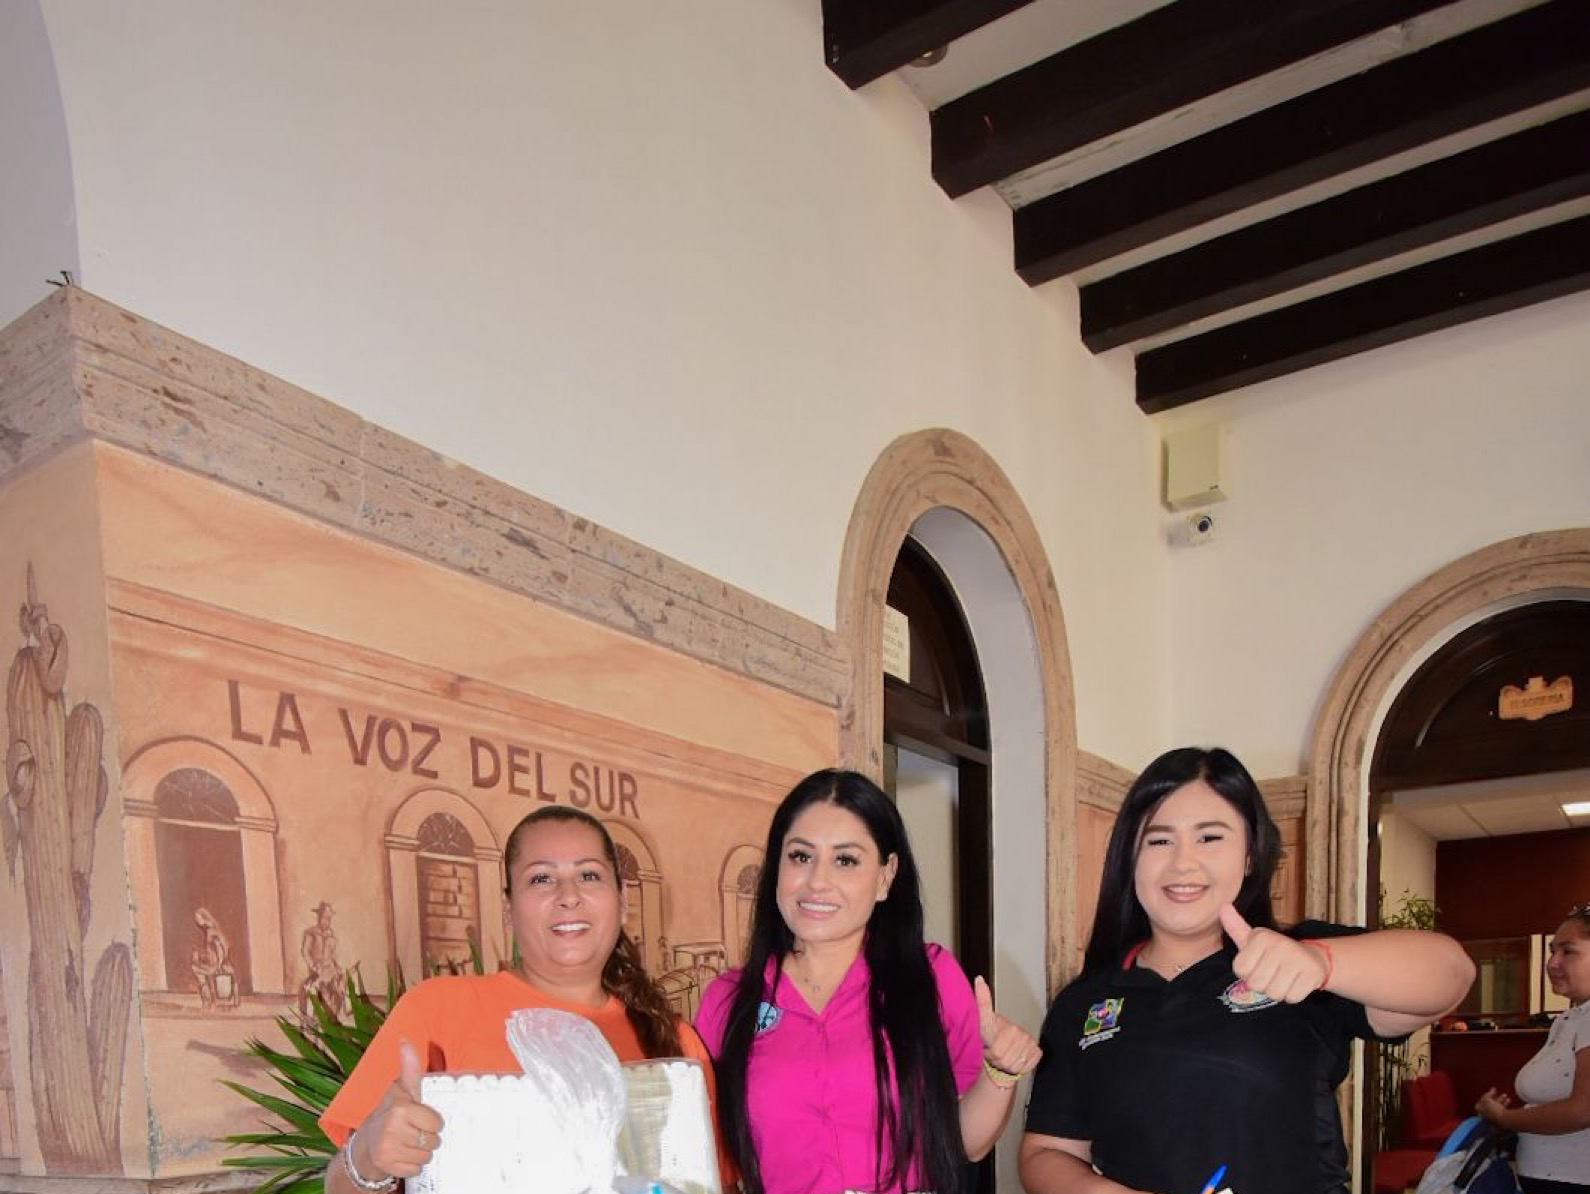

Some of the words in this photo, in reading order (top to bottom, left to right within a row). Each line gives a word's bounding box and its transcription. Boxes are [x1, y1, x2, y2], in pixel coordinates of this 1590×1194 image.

[227, 679, 312, 755] LA
[339, 707, 441, 779] VOZ
[469, 736, 556, 803] DEL
[569, 760, 641, 819] SUR
